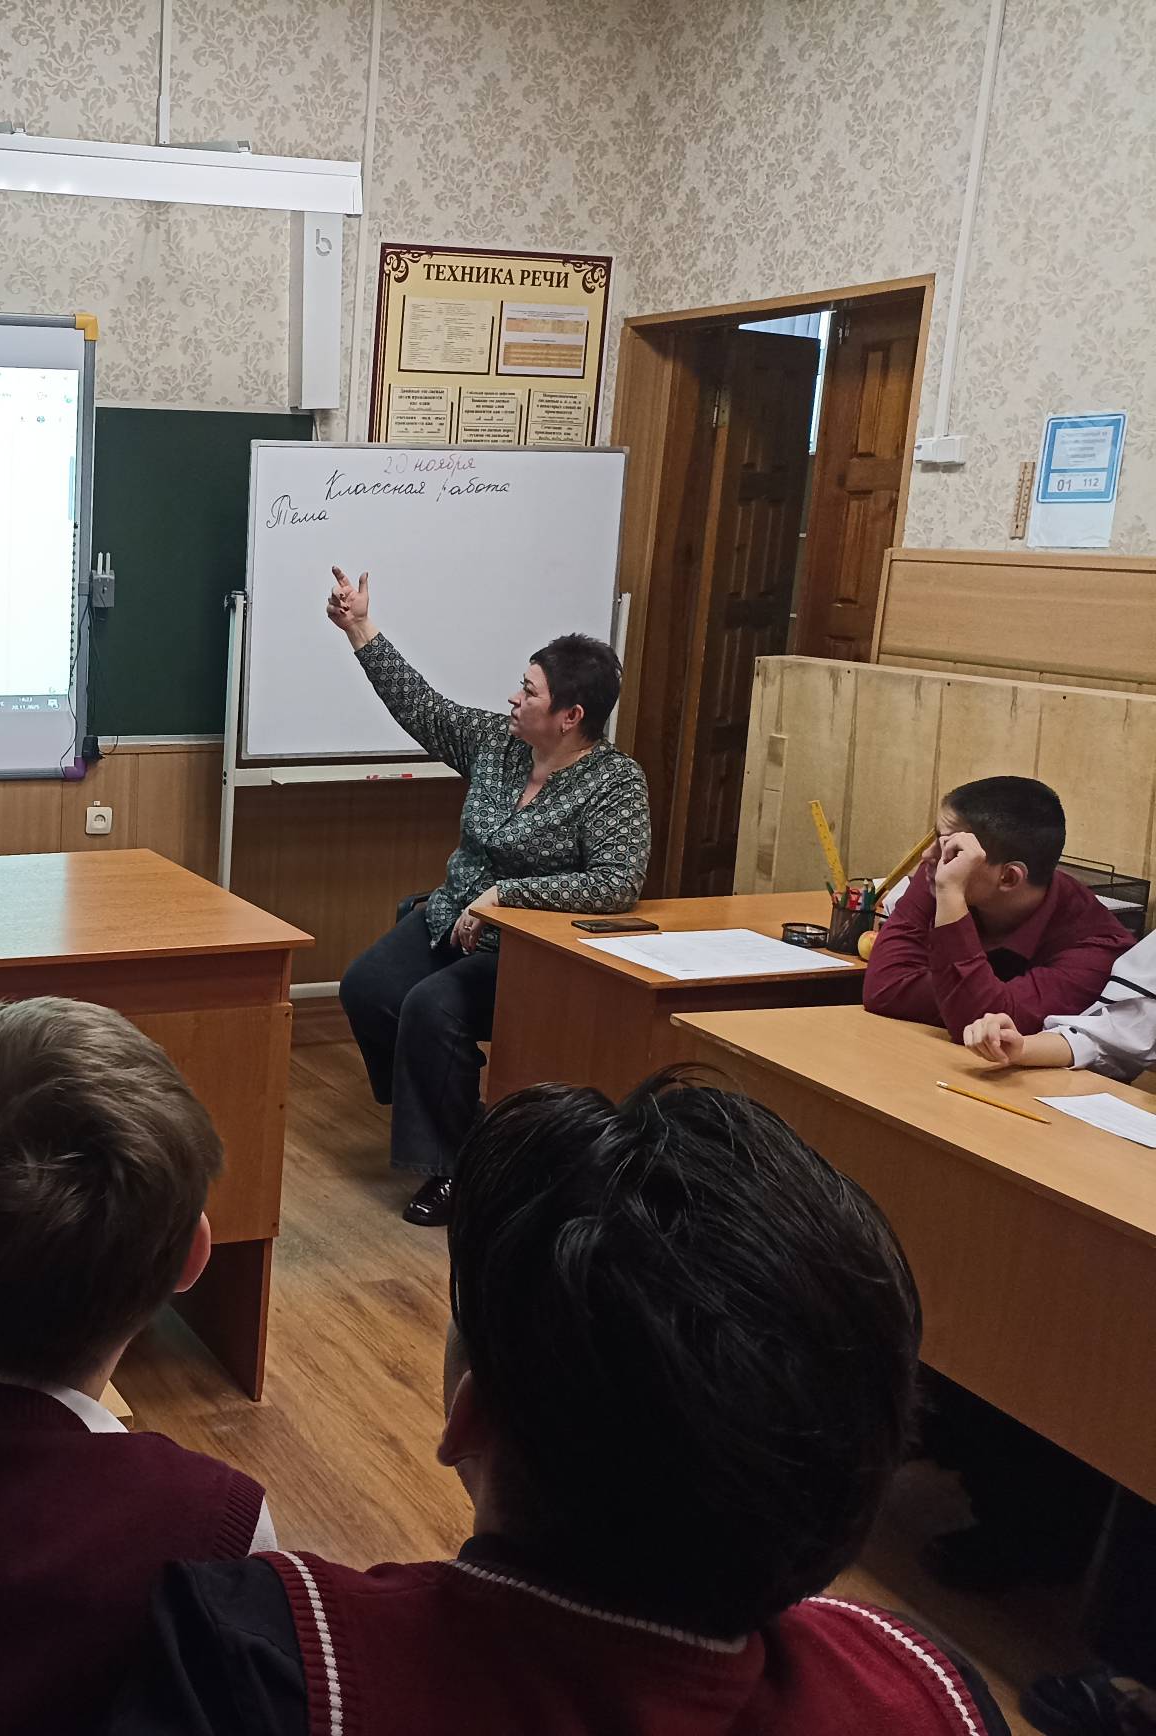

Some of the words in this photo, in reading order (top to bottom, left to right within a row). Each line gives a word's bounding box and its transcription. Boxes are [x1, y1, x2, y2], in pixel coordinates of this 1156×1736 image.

[423, 263, 515, 286] ТЕХНИКА
[519, 269, 570, 289] РЕЧИ
[413, 452, 477, 478] ноября
[325, 469, 425, 501] Классная
[1057, 479, 1072, 491] 01
[1083, 477, 1100, 488] 112
[265, 494, 330, 529] Тема
